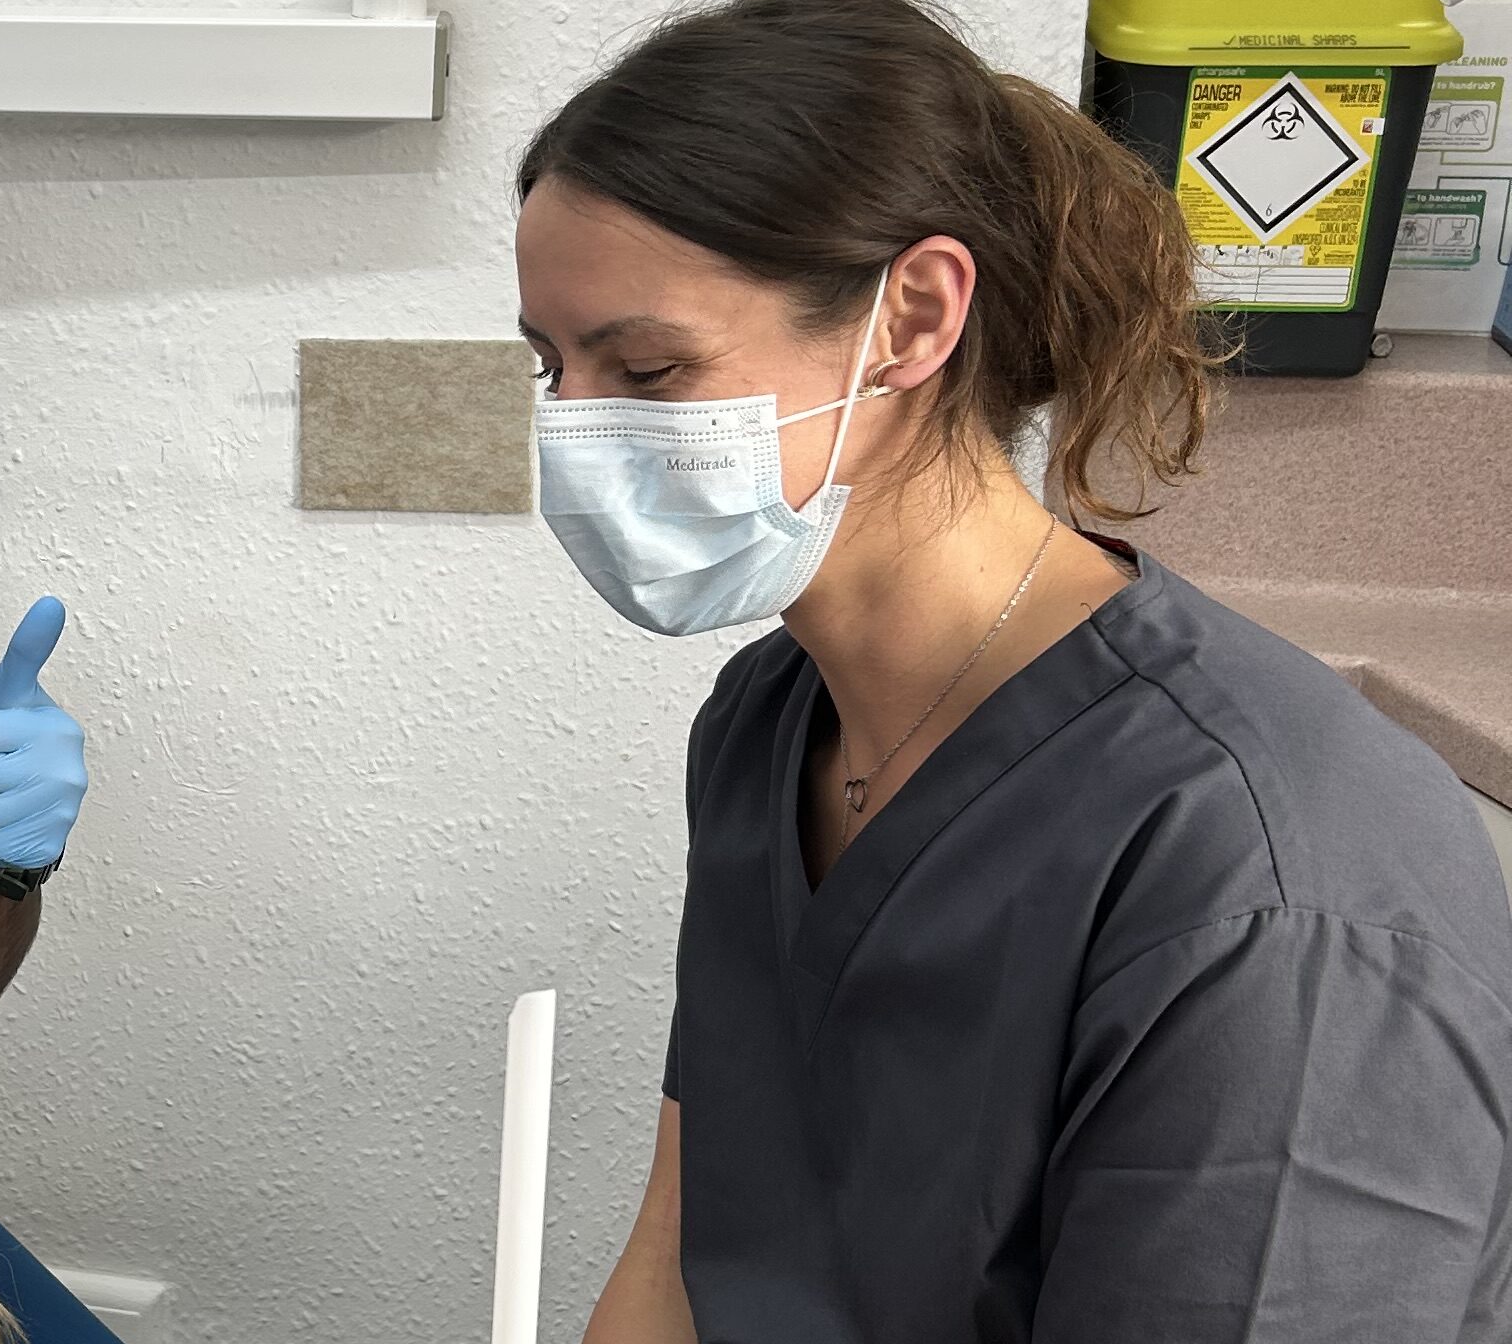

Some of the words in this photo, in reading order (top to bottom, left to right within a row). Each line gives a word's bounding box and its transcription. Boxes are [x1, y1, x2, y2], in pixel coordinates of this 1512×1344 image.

[1239, 35, 1305, 47] MEDICINAL
[1313, 34, 1357, 46] SHARPS
[1447, 56, 1508, 67] LEANING
[1193, 84, 1242, 101] DANGER
[1429, 194, 1483, 203] handwash?
[1265, 203, 1273, 217] 6
[666, 455, 737, 471] Meditrade
